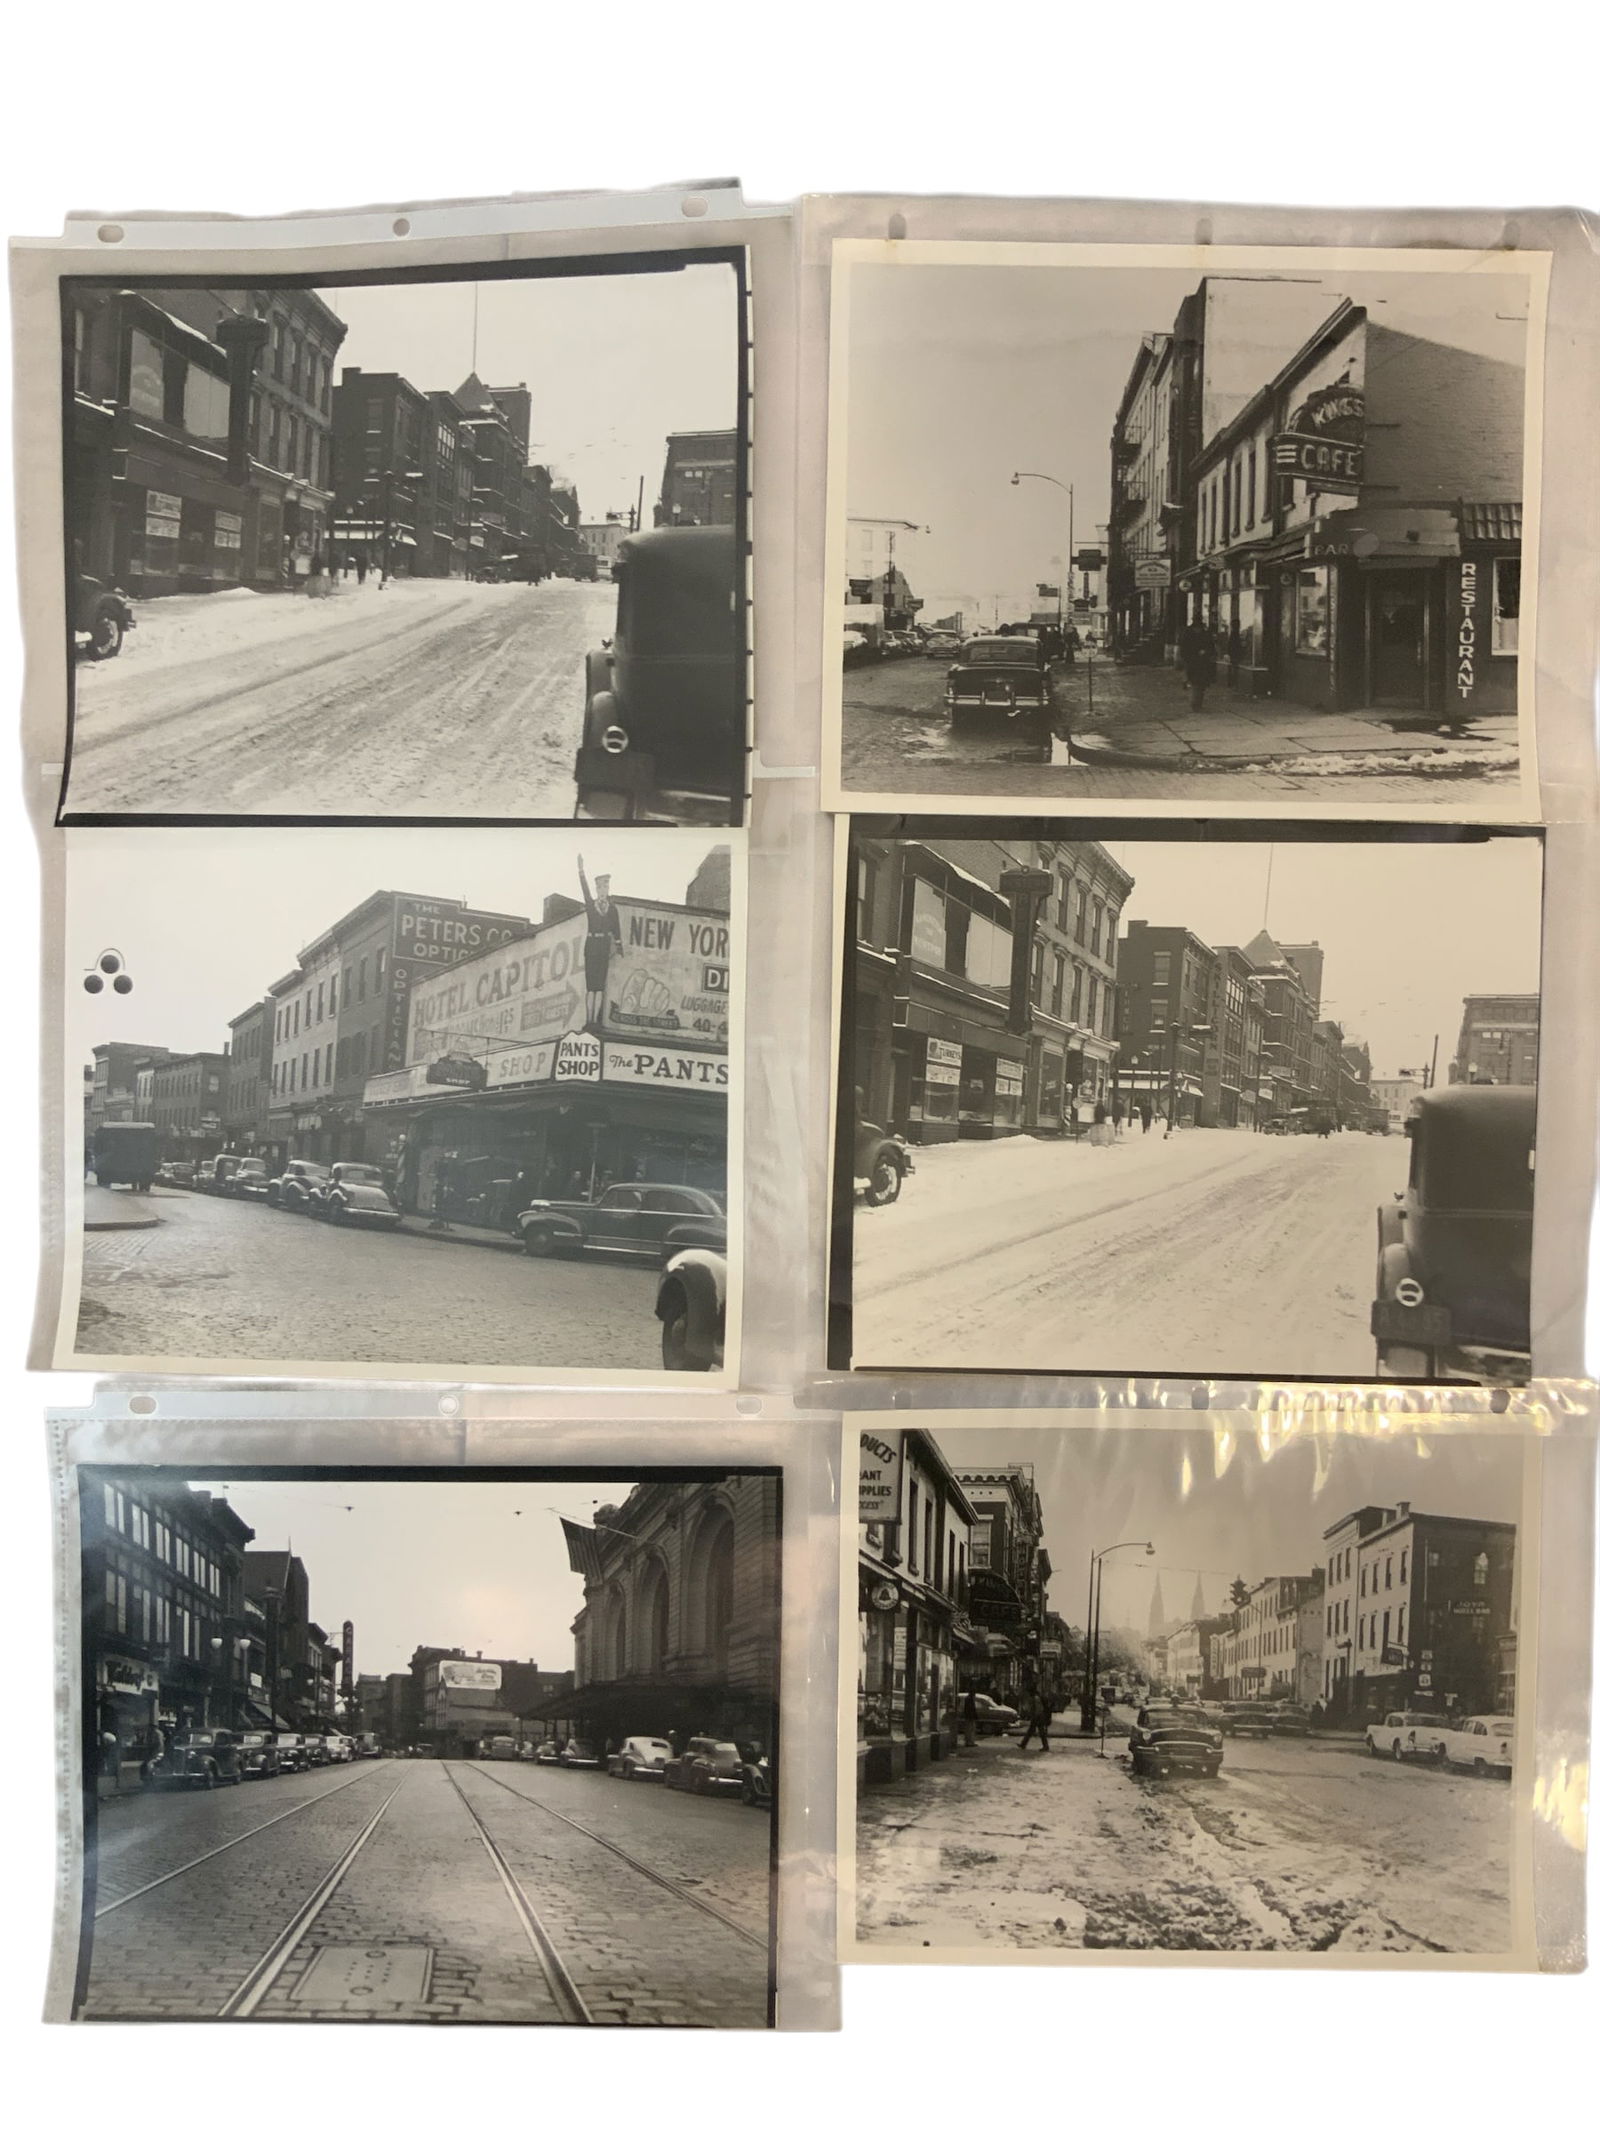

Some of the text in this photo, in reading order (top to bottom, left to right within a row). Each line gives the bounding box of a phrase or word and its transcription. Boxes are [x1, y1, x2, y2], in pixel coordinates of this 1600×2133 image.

[1311, 397, 1364, 427] KINGS
[1301, 444, 1360, 475] CAFE
[1457, 562, 1477, 698] RESTAURANT
[413, 902, 441, 915] THE
[401, 914, 481, 946] PETERS
[629, 915, 675, 950] NEW
[413, 942, 475, 962] OPTIC
[414, 983, 471, 1028] HOTEL
[476, 935, 586, 1007] CAPITOL
[560, 1042, 599, 1058] PANTS
[500, 1052, 547, 1079] SHOP
[557, 1059, 599, 1076] SHOP
[609, 1053, 729, 1085] The PANTS
[860, 1470, 882, 1481] ANT
